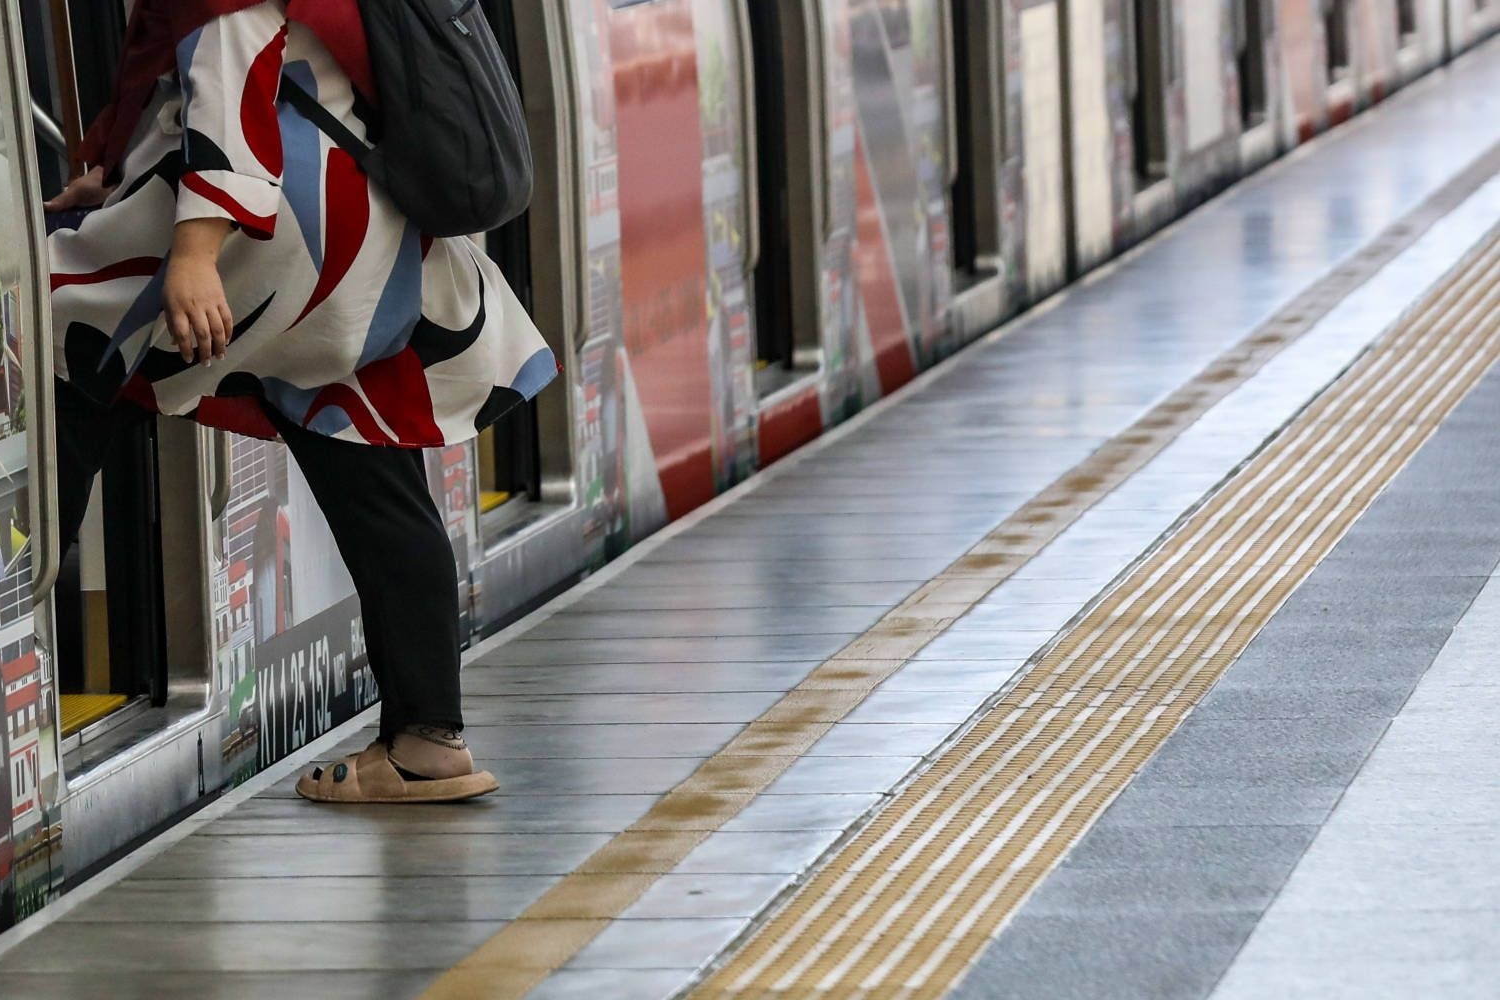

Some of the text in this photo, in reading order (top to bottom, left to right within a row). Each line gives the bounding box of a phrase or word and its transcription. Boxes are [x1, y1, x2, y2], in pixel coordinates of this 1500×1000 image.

[258, 662, 276, 769] K1
[290, 648, 307, 751] 25
[308, 634, 332, 738] 152
